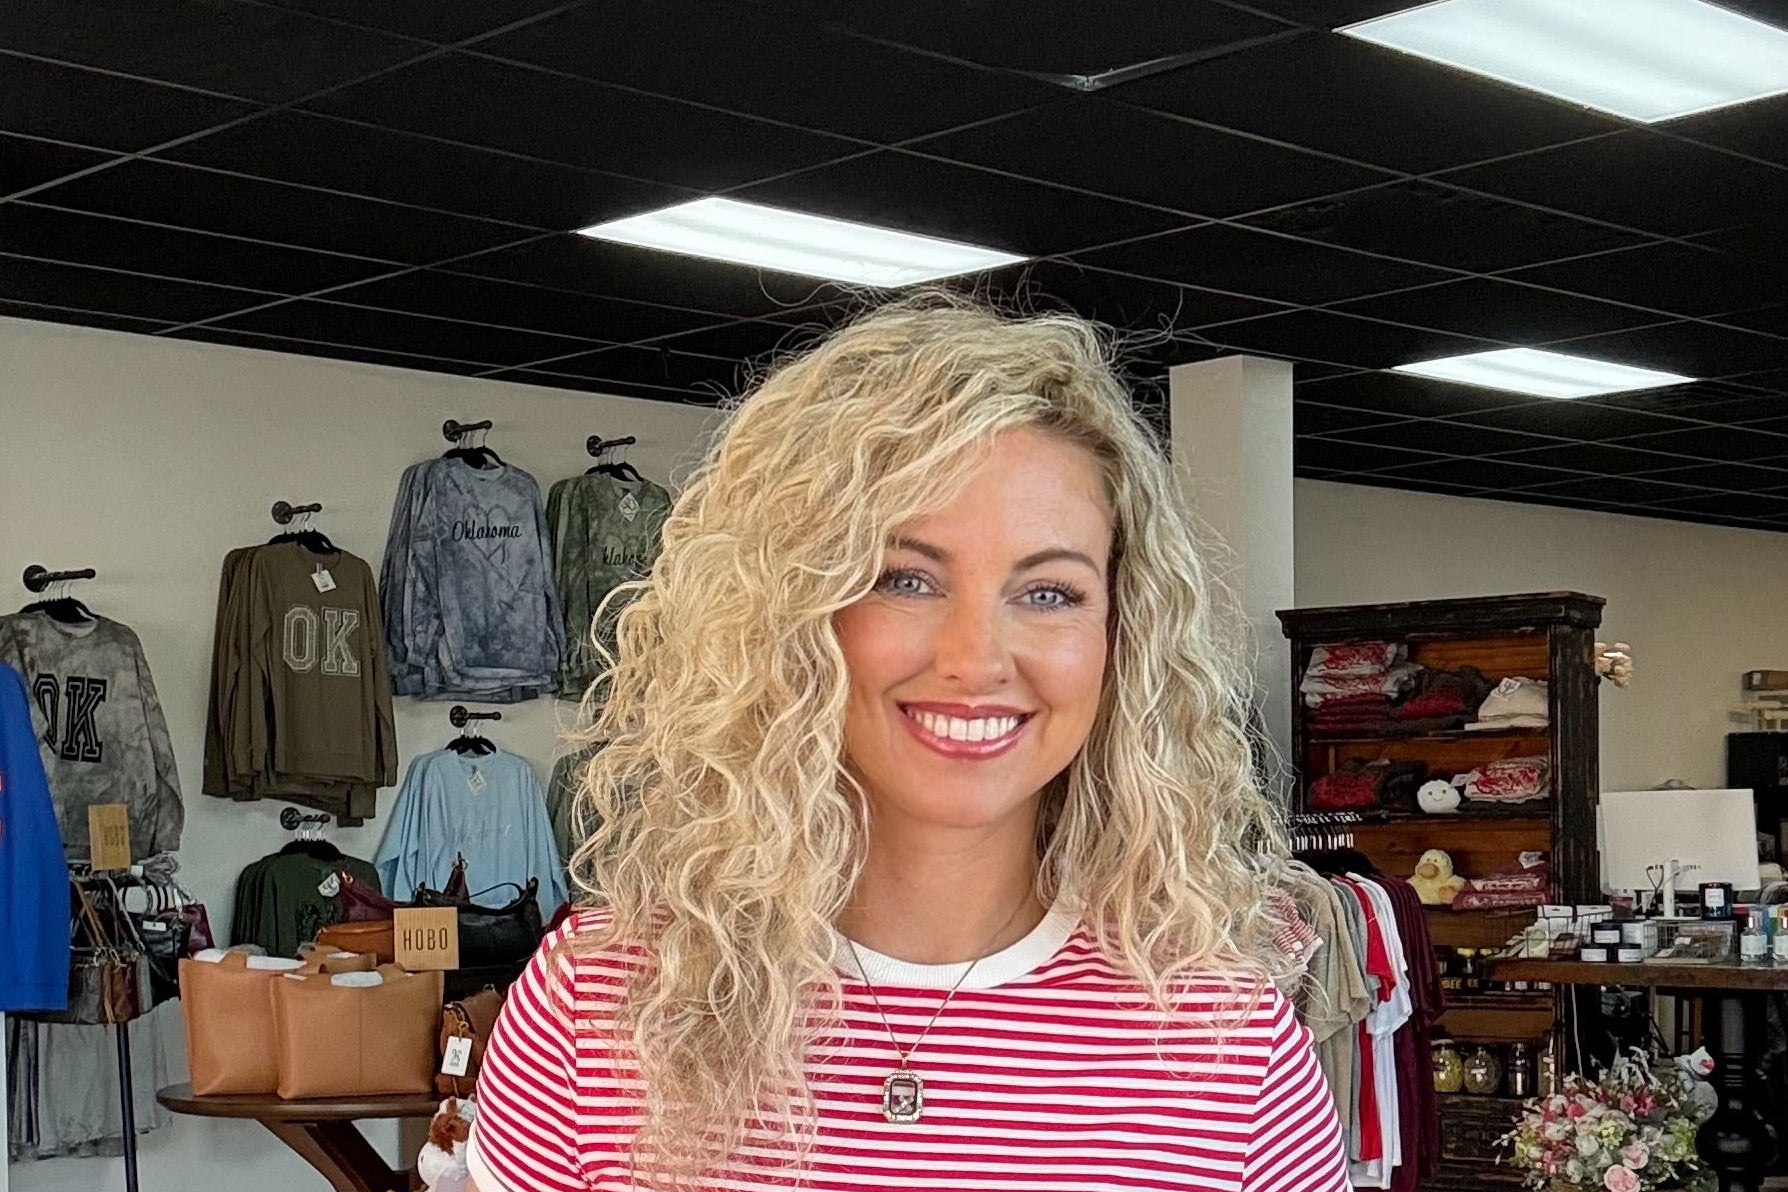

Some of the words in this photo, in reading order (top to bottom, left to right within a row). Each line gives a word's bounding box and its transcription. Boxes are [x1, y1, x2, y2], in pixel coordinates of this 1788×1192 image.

[452, 519, 522, 542] Oklahoma
[283, 604, 361, 677] OK
[33, 673, 107, 763] OK
[403, 927, 448, 951] HOBO
